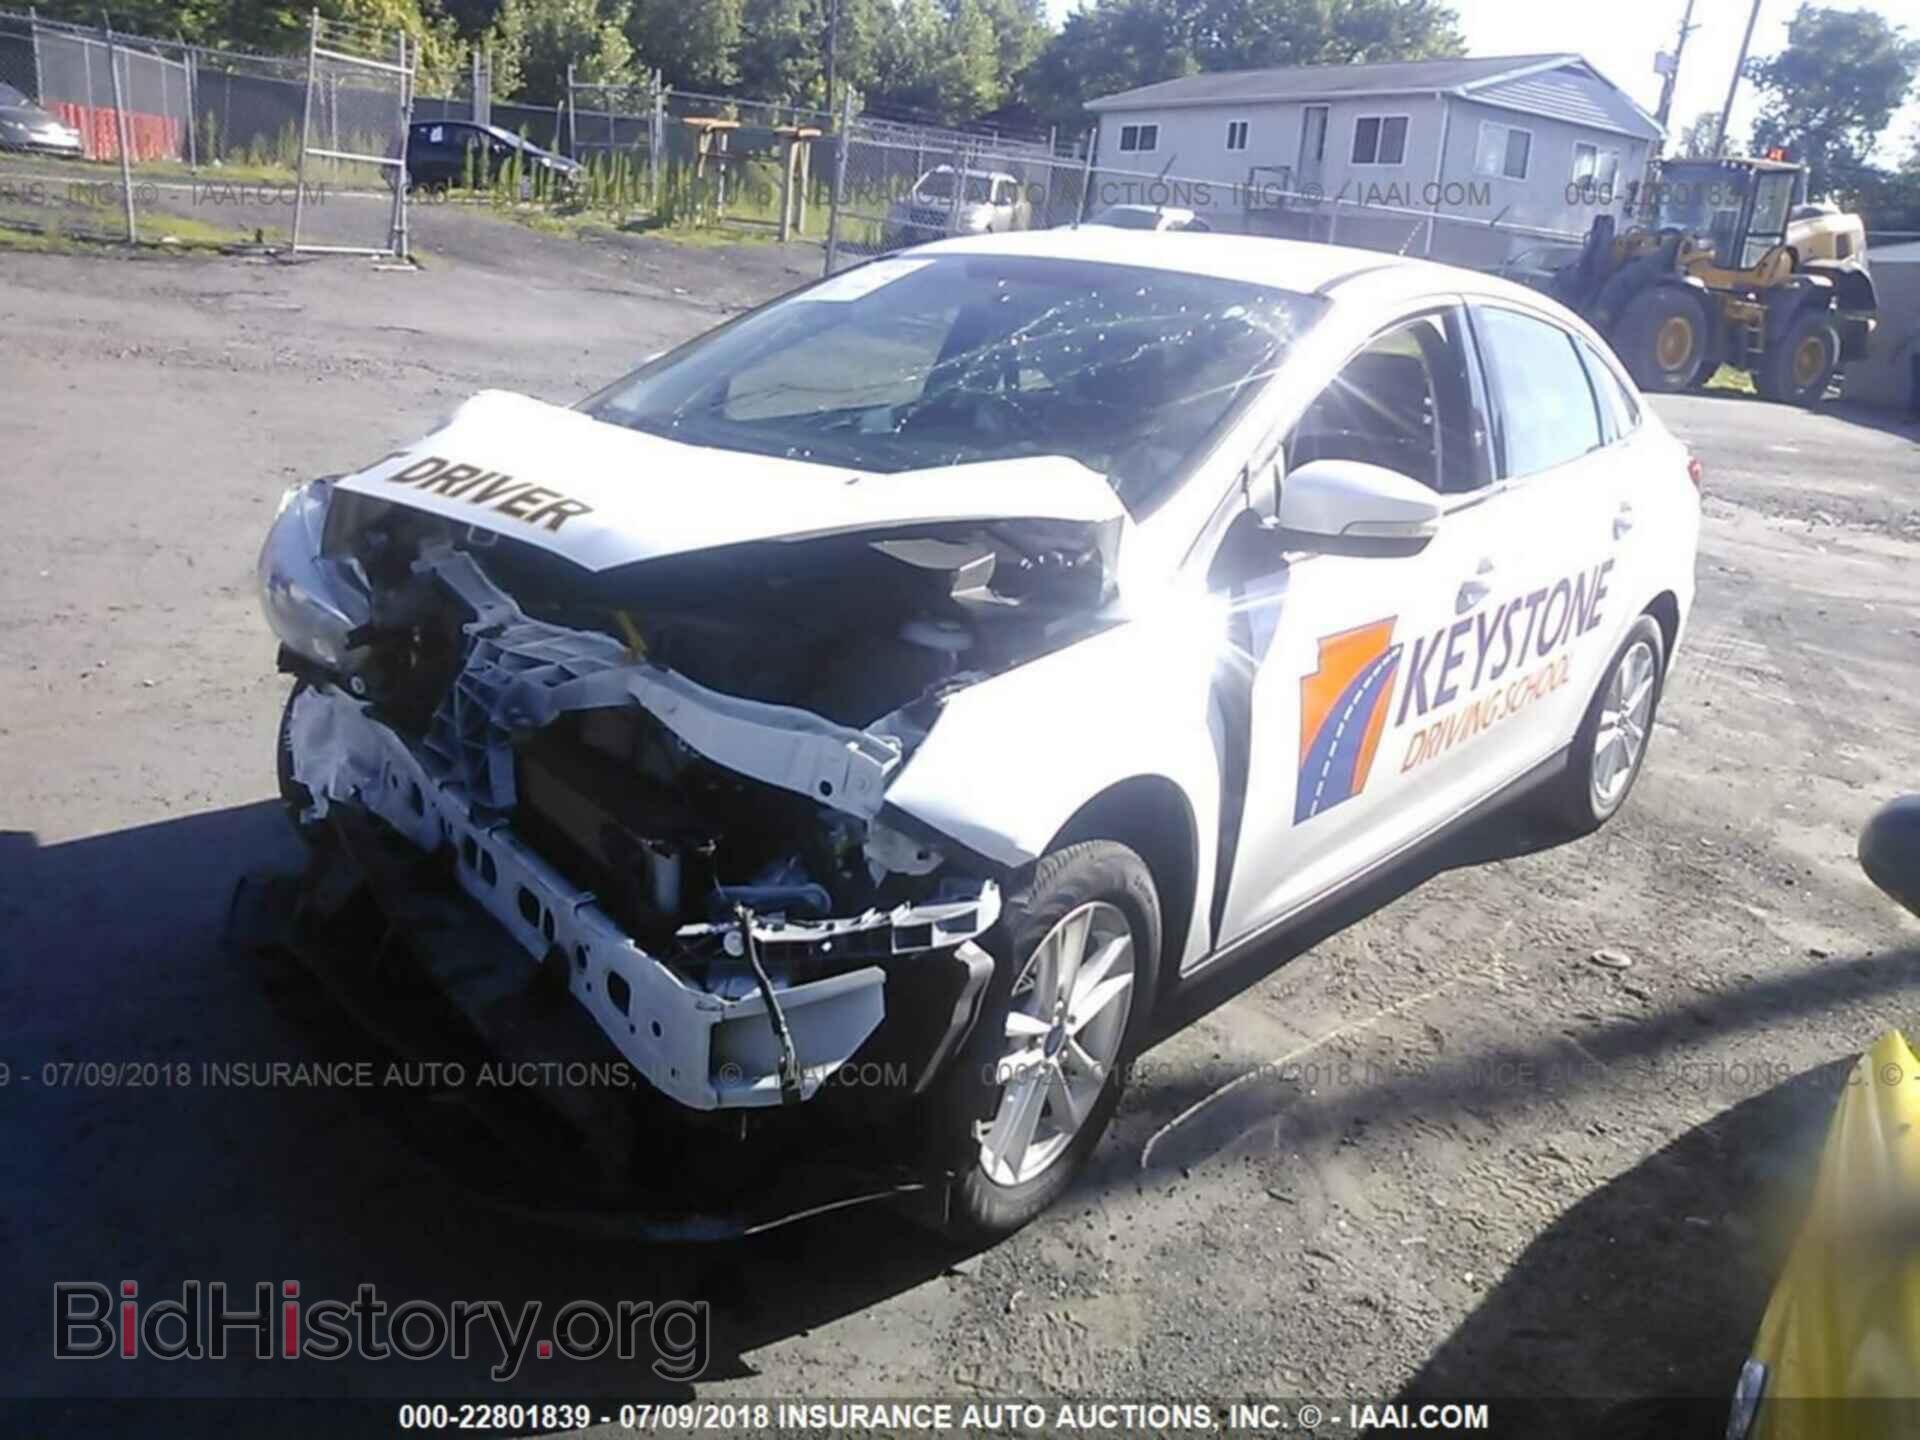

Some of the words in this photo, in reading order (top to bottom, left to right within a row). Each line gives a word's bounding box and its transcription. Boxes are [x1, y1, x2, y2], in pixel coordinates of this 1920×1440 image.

[386, 456, 593, 532] DRIVER
[1395, 557, 1615, 727] KEYSTONE
[1401, 690, 1502, 773] DRIVING
[1499, 655, 1569, 720] SCHOOL
